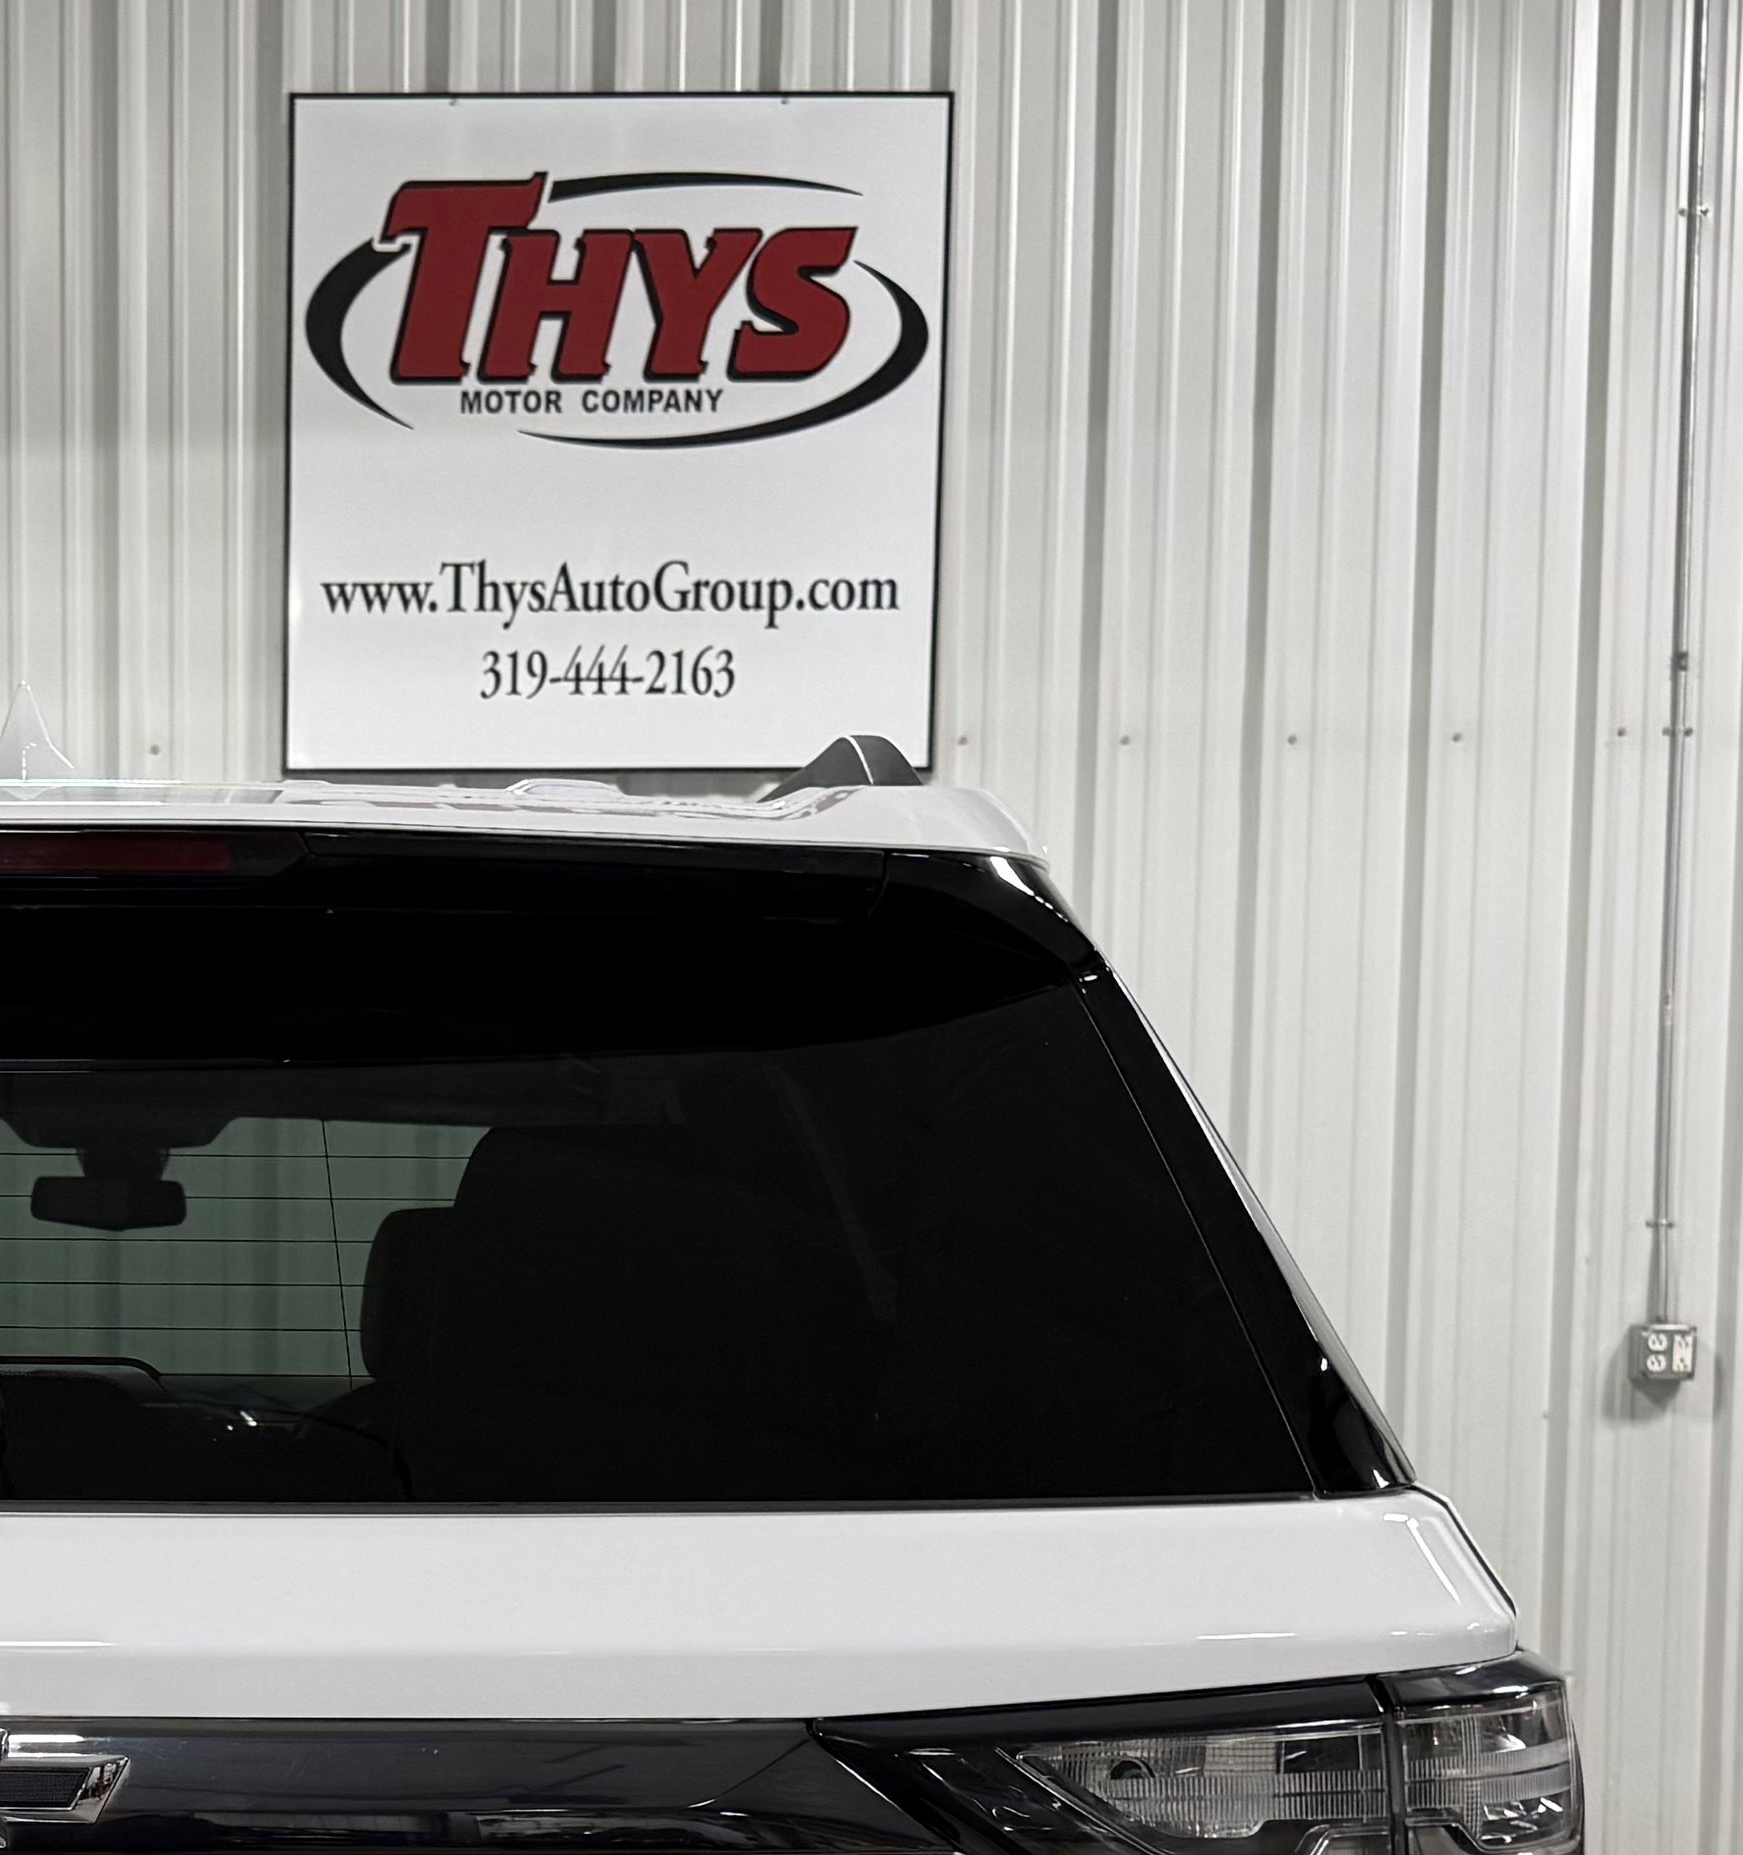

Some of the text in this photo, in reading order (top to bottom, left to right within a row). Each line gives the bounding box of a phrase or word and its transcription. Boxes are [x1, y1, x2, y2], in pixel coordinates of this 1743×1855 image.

[379, 171, 858, 384] THYS
[460, 388, 724, 414] MOTOR COMPANY
[321, 560, 900, 629] www.ThysAutoGroup.com
[480, 644, 736, 699] 319-444-2163
